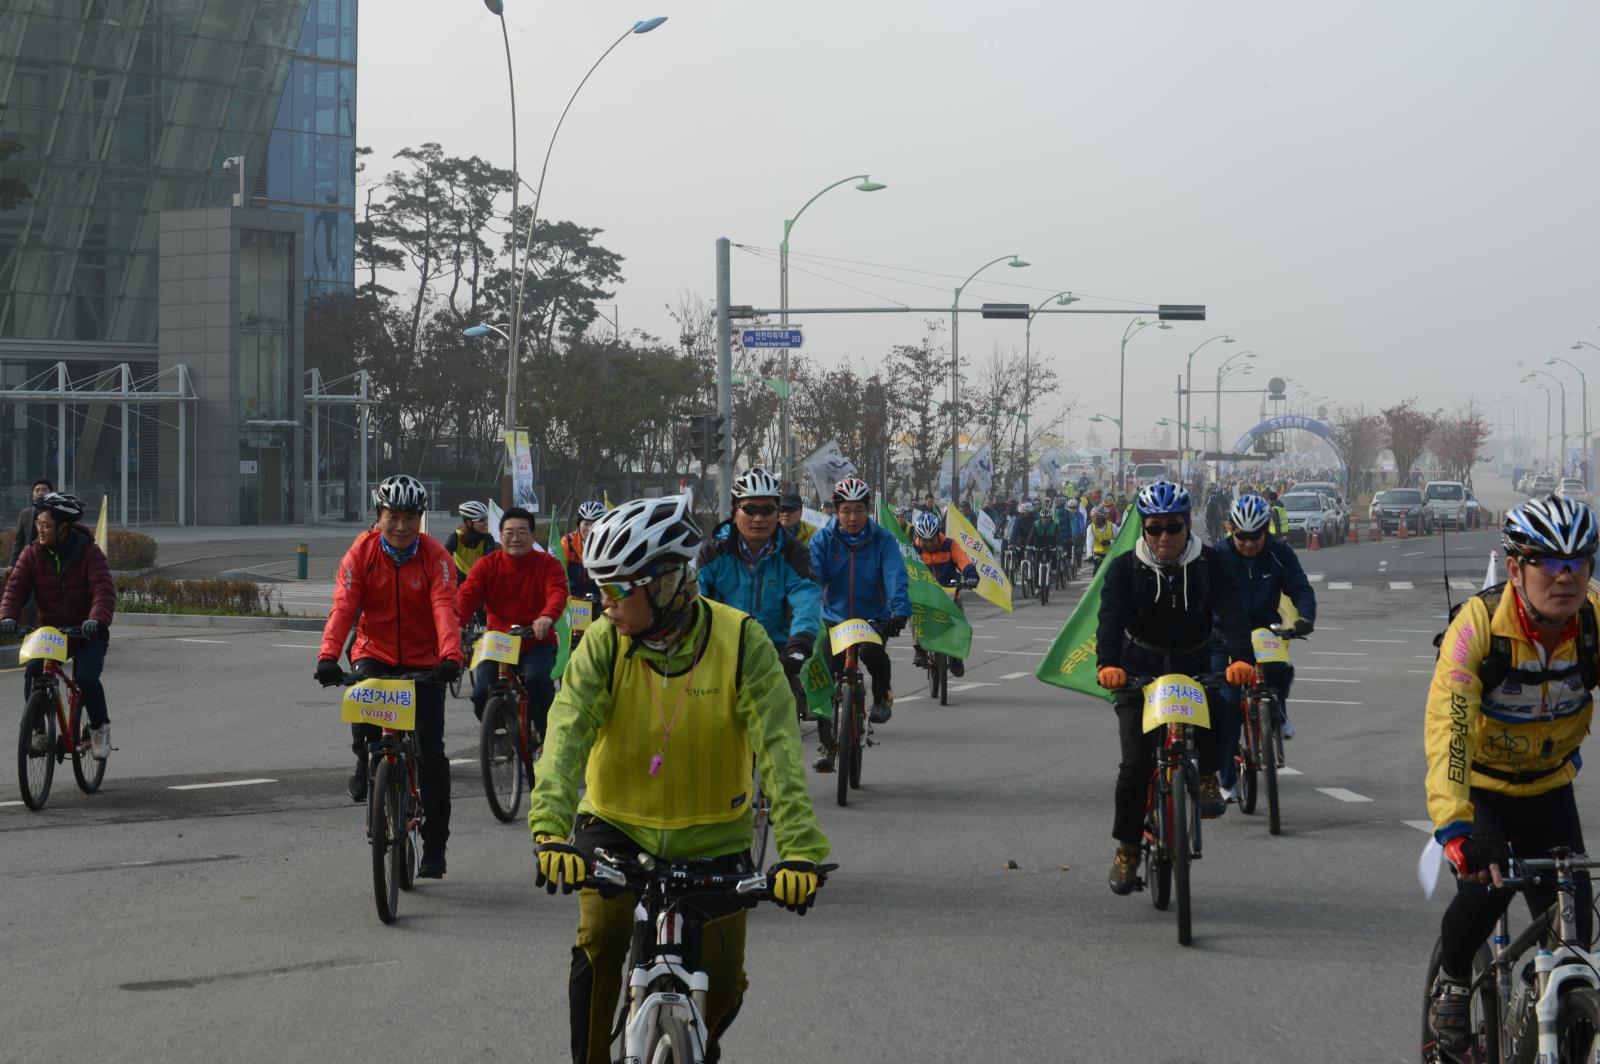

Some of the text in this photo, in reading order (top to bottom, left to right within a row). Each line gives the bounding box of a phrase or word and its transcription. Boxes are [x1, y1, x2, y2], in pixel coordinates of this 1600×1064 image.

[744, 335, 754, 343] 249
[791, 335, 801, 343] 255
[1269, 417, 1310, 429] START
[348, 687, 412, 706] 자전거사랑
[360, 707, 398, 721] (VIP용)
